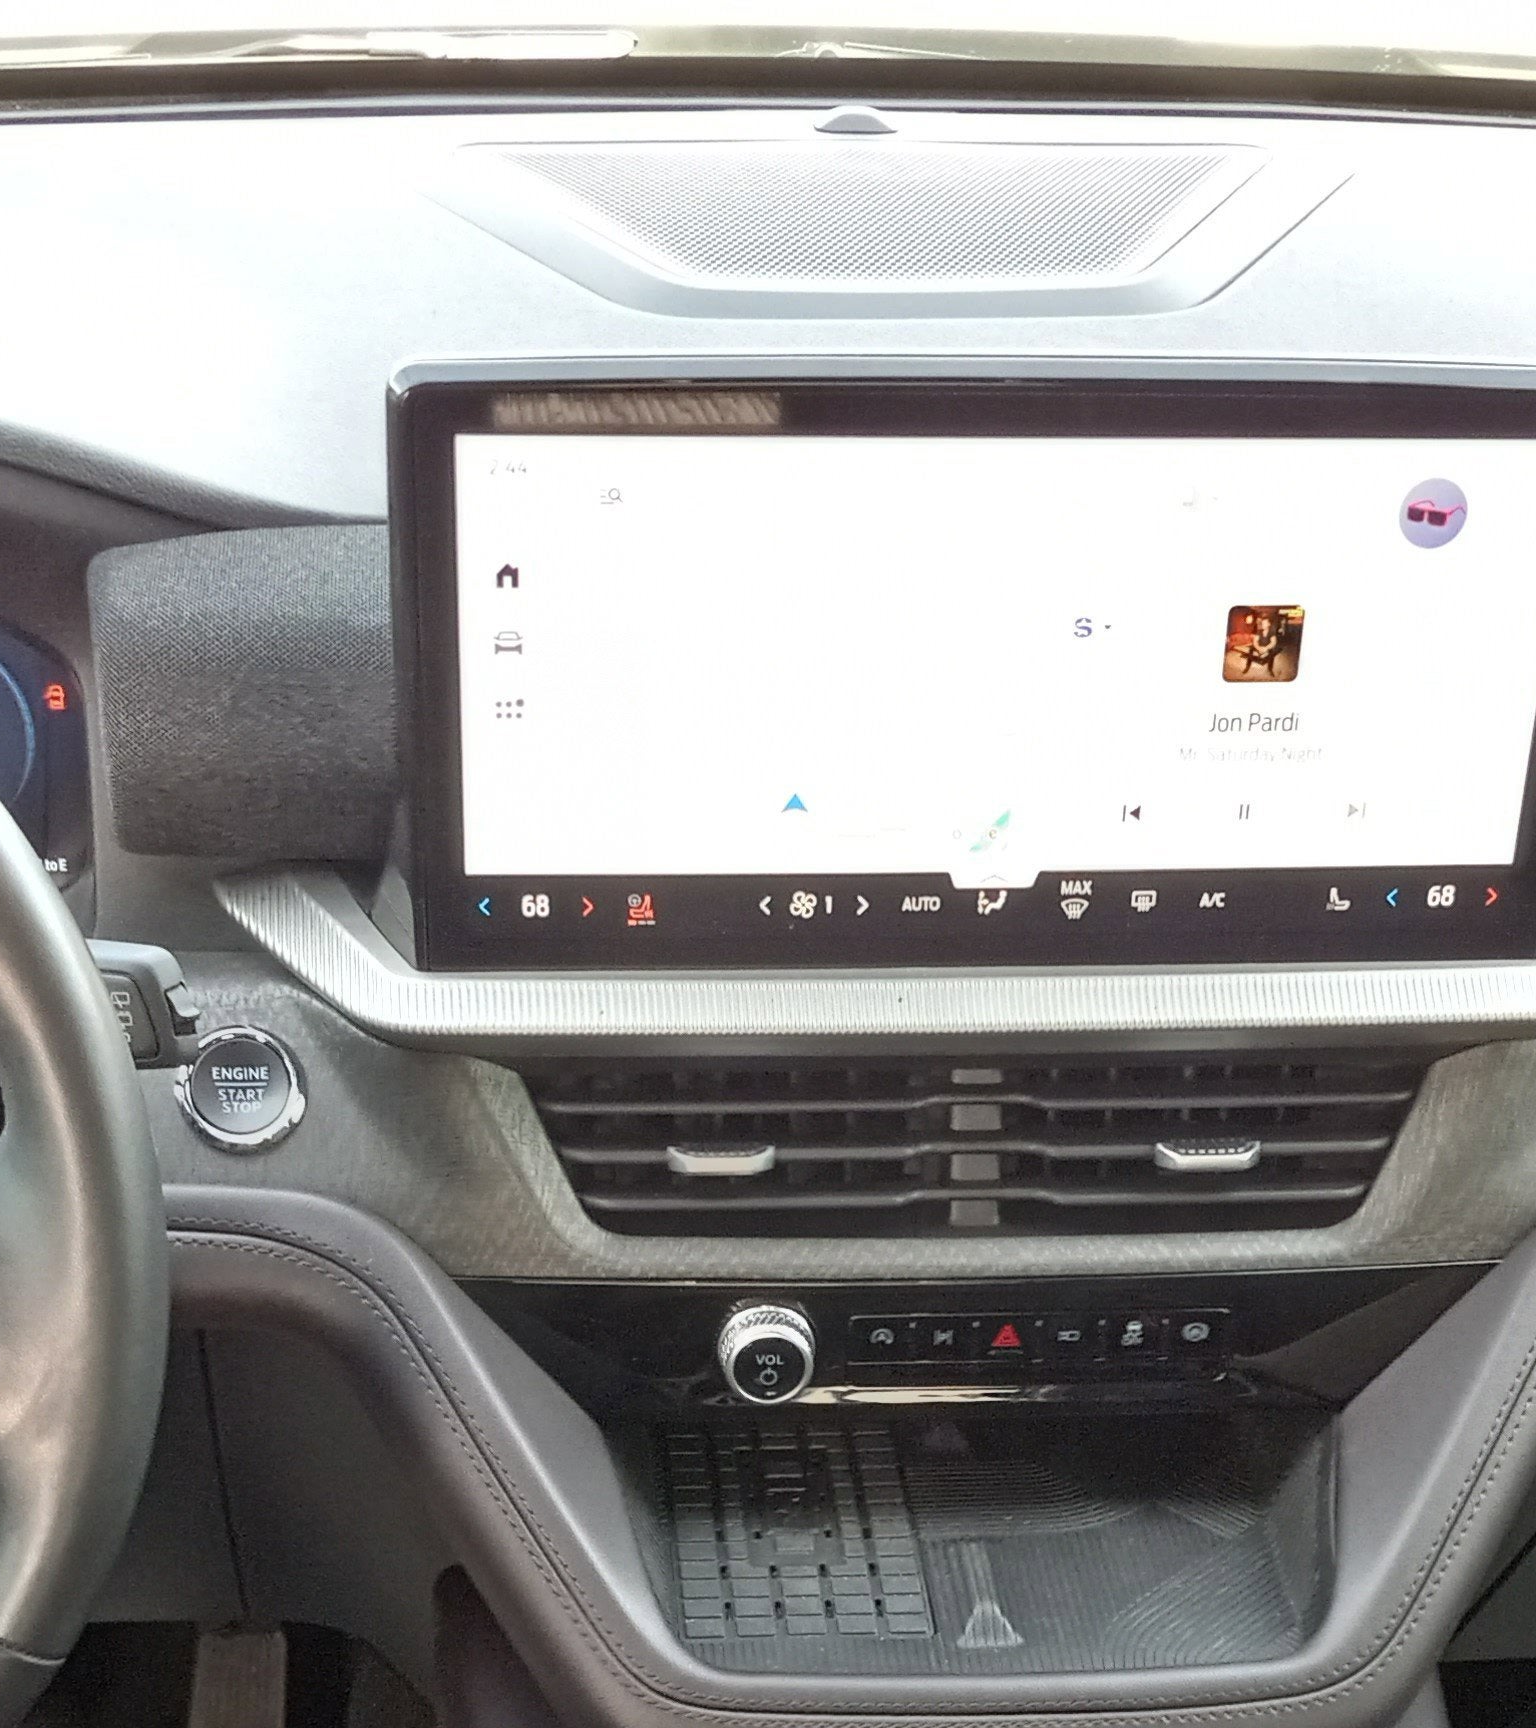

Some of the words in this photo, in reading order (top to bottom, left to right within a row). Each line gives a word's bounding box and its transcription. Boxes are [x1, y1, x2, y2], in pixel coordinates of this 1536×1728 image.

[1208, 712, 1242, 733] Jon
[1248, 711, 1299, 732] Pardi
[1060, 880, 1093, 896] MAX
[1426, 884, 1456, 908] 68
[520, 893, 551, 918] 68
[901, 896, 941, 912] AUTO
[1198, 891, 1226, 908] A/C
[211, 1066, 270, 1081] ENGINE
[218, 1088, 265, 1101] START
[222, 1101, 263, 1114] STOP
[755, 1354, 785, 1366] VOL
